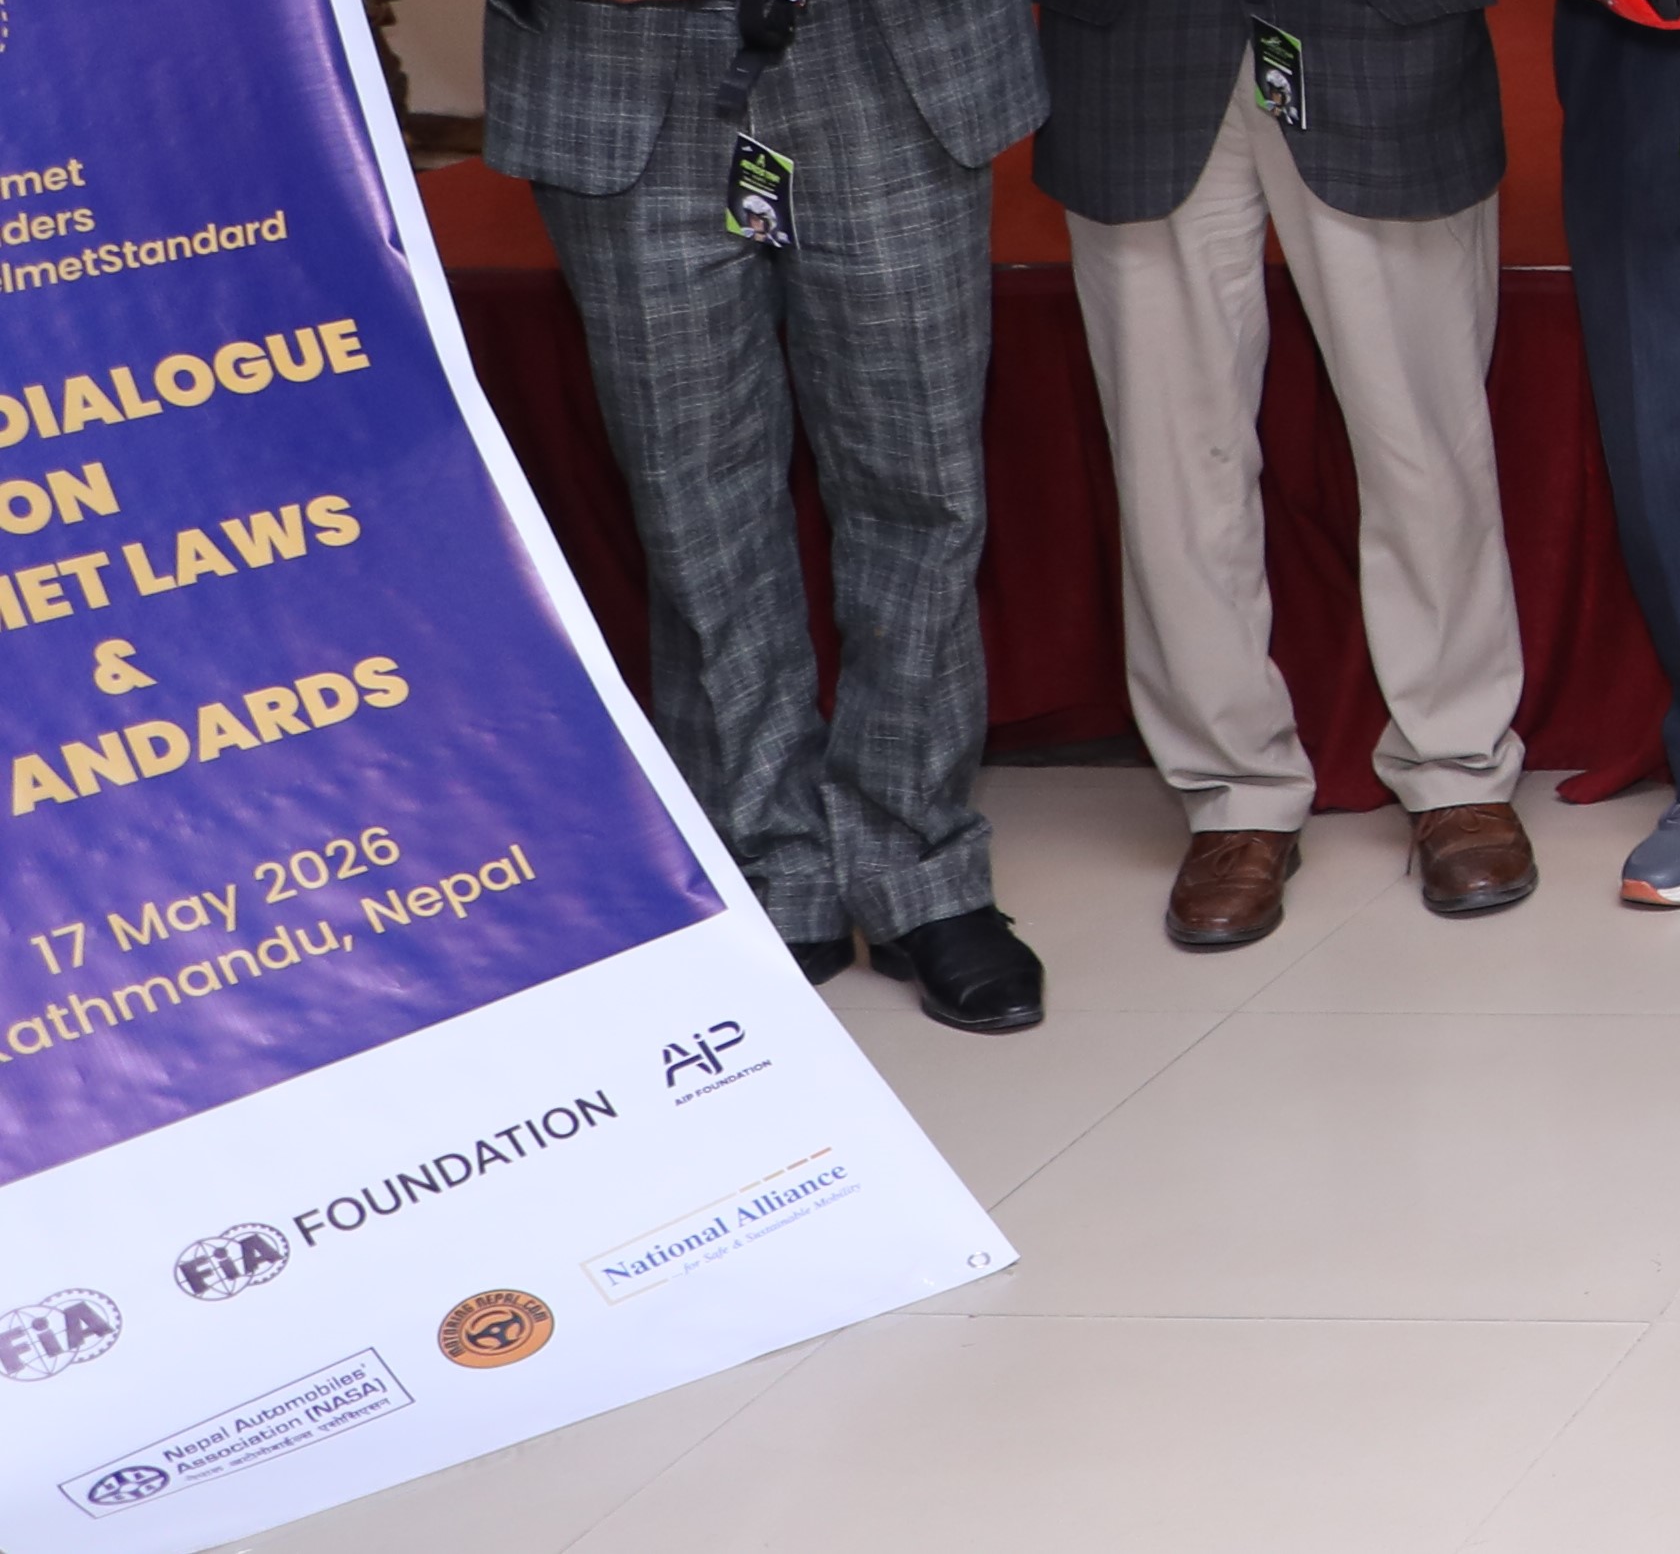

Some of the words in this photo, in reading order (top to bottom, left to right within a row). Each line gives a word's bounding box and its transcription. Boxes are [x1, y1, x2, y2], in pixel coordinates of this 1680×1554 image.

[0, 210, 288, 293] lmetStandard
[0, 462, 121, 535] ON
[121, 494, 362, 597] LAWS
[92, 639, 157, 697] &
[10, 656, 411, 817] ANDARDS
[30, 922, 86, 975] 17
[106, 878, 241, 955] May
[253, 825, 403, 903] 2026
[0, 913, 355, 1062] athmandu,
[360, 844, 538, 936] Nepal
[694, 1059, 773, 1098] FOUNDATION
[292, 1090, 619, 1247] FOUNDATION
[601, 1217, 731, 1287] National
[735, 1162, 850, 1230] Alliance
[703, 1243, 731, 1265] Safe
[745, 1206, 813, 1243] Sustainable
[813, 1180, 863, 1213] Mobility
[448, 1301, 476, 1358] MOTORING
[162, 1425, 230, 1463] Nepal
[234, 1362, 367, 1433] Automobiles'
[175, 1416, 303, 1475] Association
[303, 1377, 389, 1423] (NASA)
